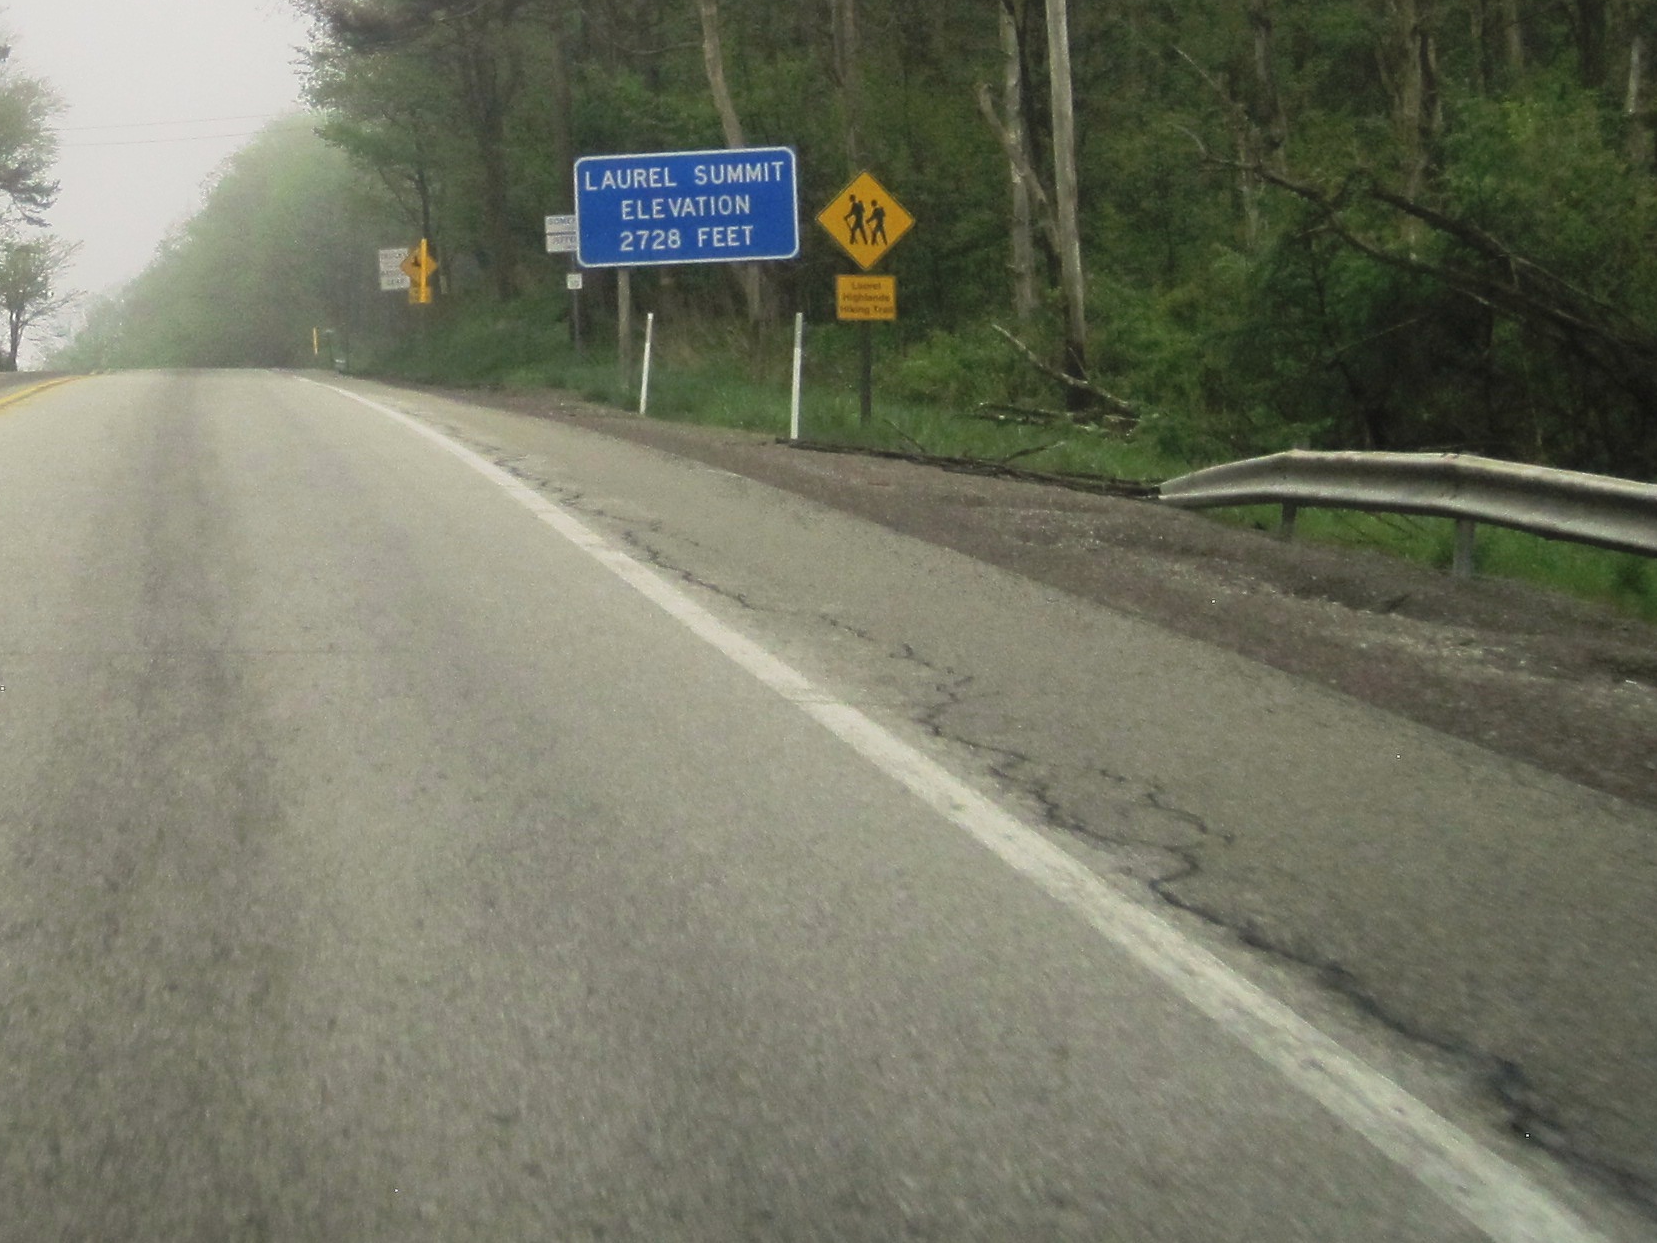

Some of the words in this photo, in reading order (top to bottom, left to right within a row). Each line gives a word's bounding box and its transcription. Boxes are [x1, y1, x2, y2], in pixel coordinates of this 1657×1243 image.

[585, 166, 678, 191] LAUREL
[694, 161, 785, 186] SUMMIT
[621, 194, 751, 221] ELEVATION
[619, 227, 682, 252] 2728
[697, 224, 755, 248] FEET
[852, 282, 882, 290] Laurel
[842, 293, 891, 303] Highlands
[840, 305, 871, 315] Hiking
[874, 305, 894, 314] Trail
